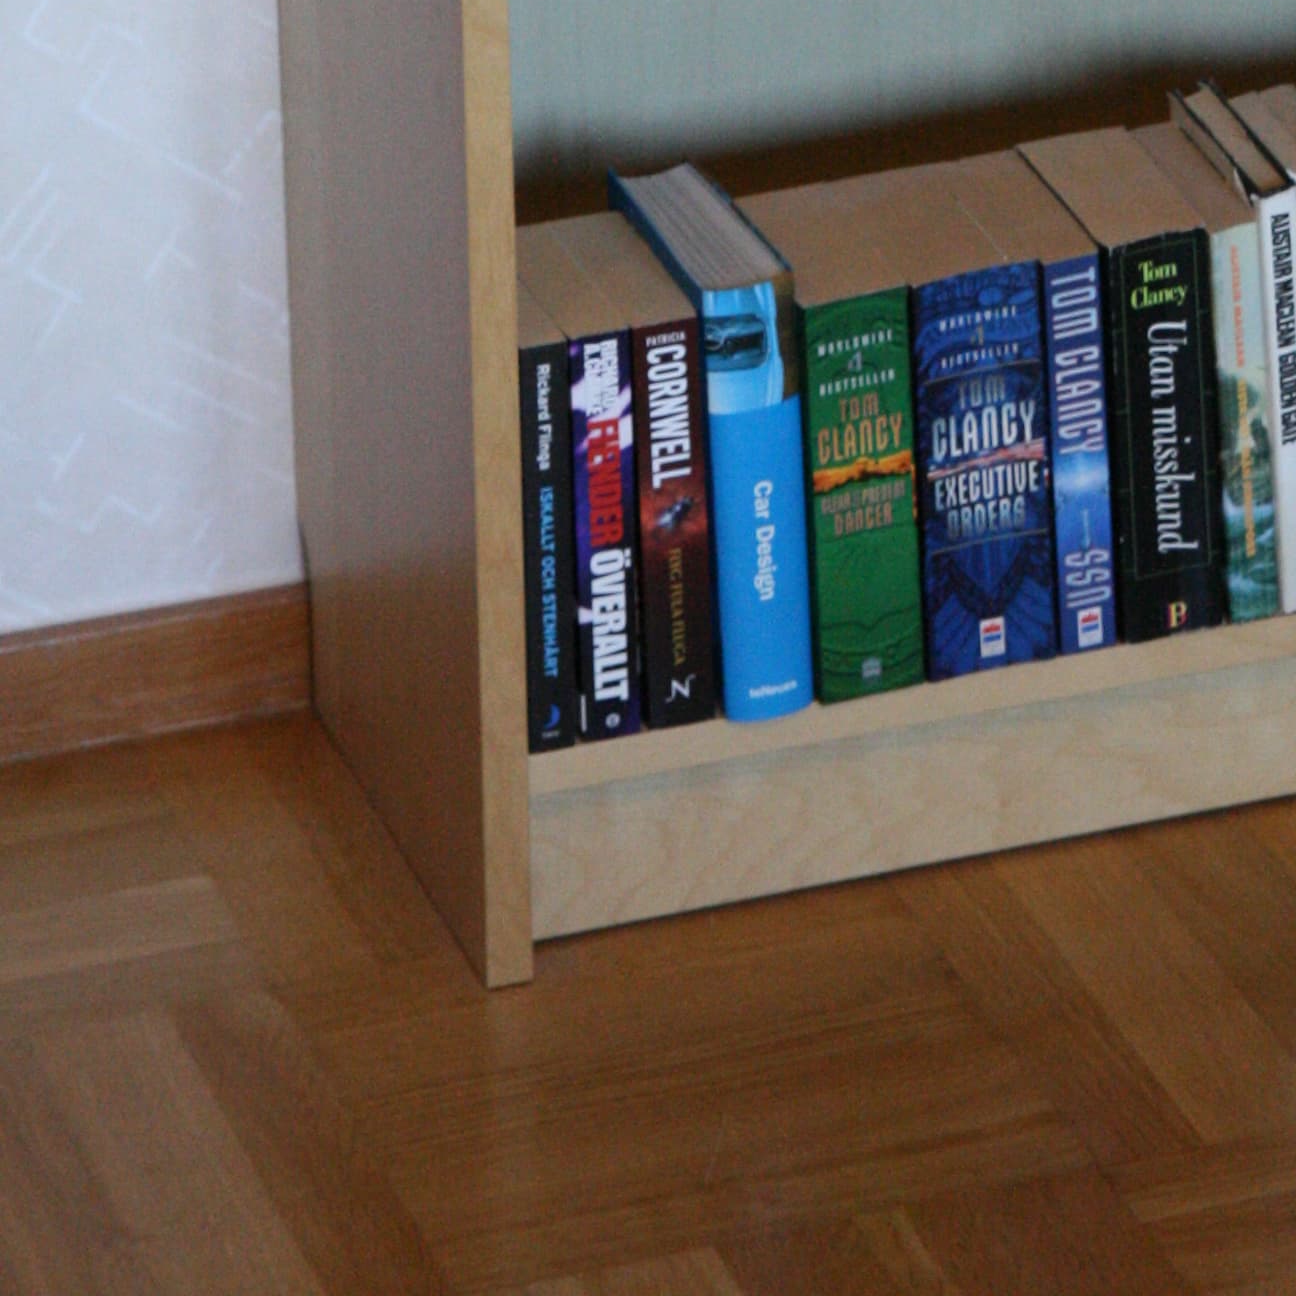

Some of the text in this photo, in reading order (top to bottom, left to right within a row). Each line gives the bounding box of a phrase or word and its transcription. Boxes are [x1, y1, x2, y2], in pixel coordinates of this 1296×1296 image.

[1270, 213, 1296, 348] ALISTAIR MACLEAN
[647, 342, 692, 488] CORNWELL
[1050, 268, 1104, 455] TOM CLANCY
[818, 411, 902, 464] CLANCY
[932, 399, 1036, 461] CLANCY
[935, 461, 1039, 511] EXECUTIVE
[1147, 320, 1199, 552] Utan misskund
[587, 418, 632, 701] FIENDER ÖVERALLT
[753, 480, 775, 601] Car Design
[948, 496, 1025, 537] ORDERS
[1064, 549, 1111, 608] SSN
